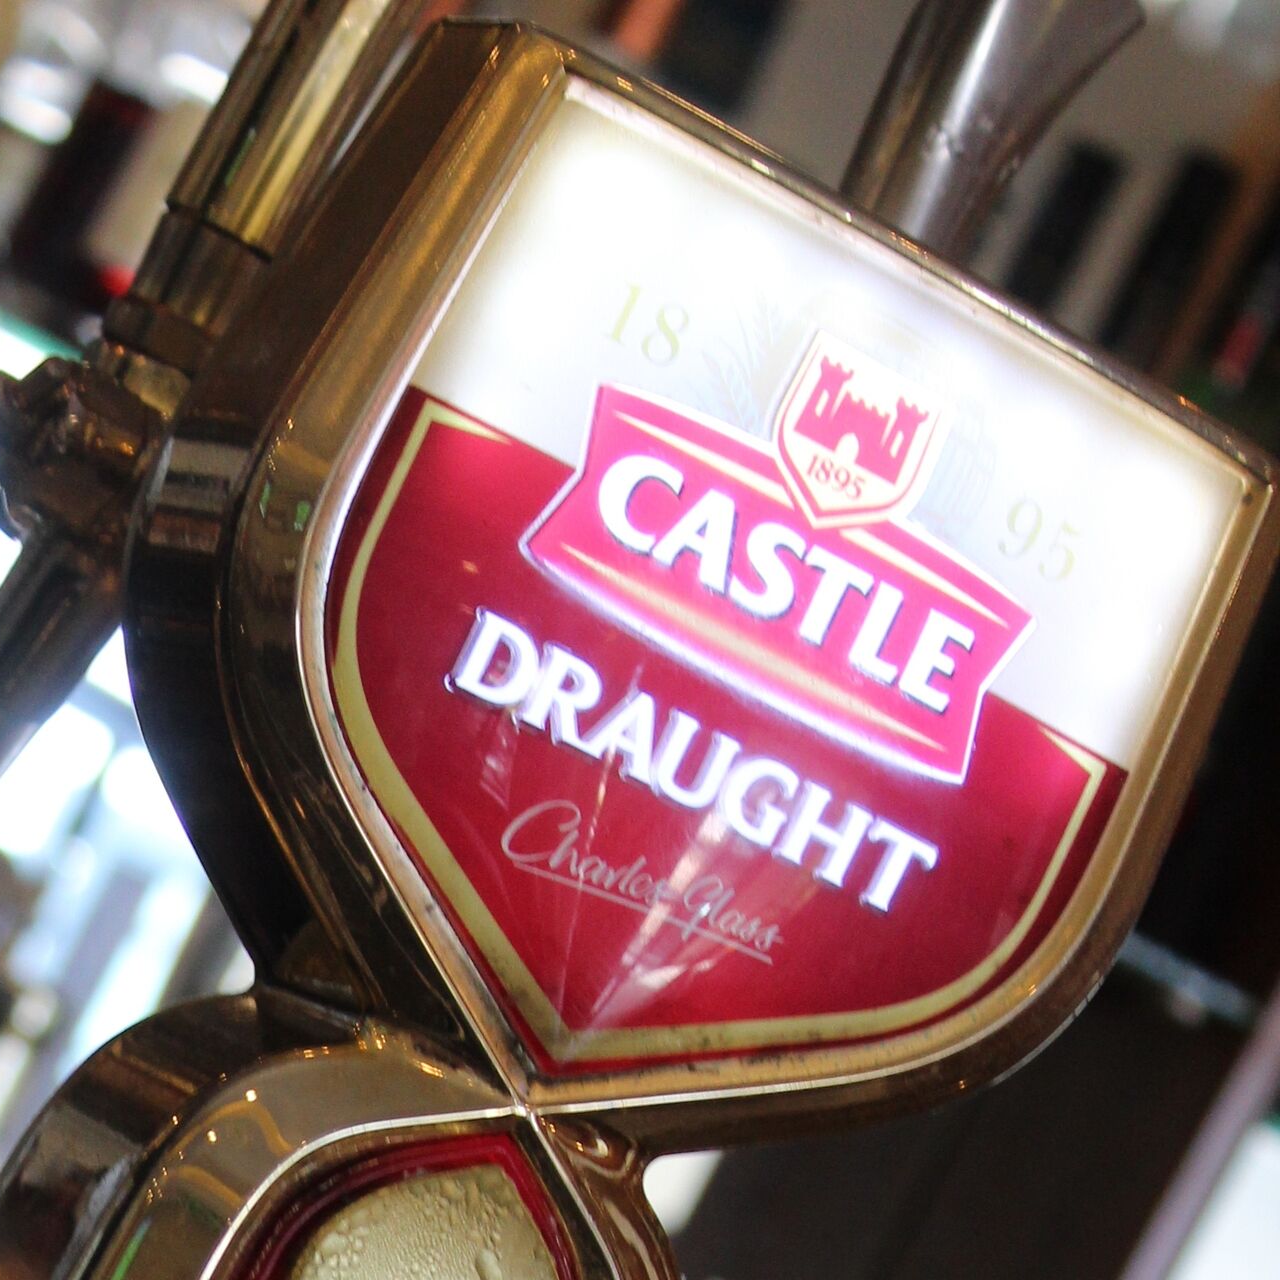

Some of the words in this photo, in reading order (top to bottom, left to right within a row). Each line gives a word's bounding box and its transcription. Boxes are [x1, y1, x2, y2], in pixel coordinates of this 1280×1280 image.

[601, 280, 690, 367] 18
[995, 497, 1084, 583] 95
[804, 453, 867, 501] 1895
[596, 453, 974, 716] CASTLE
[443, 605, 940, 913] DRAUGHT
[501, 798, 678, 907] Charles
[681, 873, 784, 951] Glass
